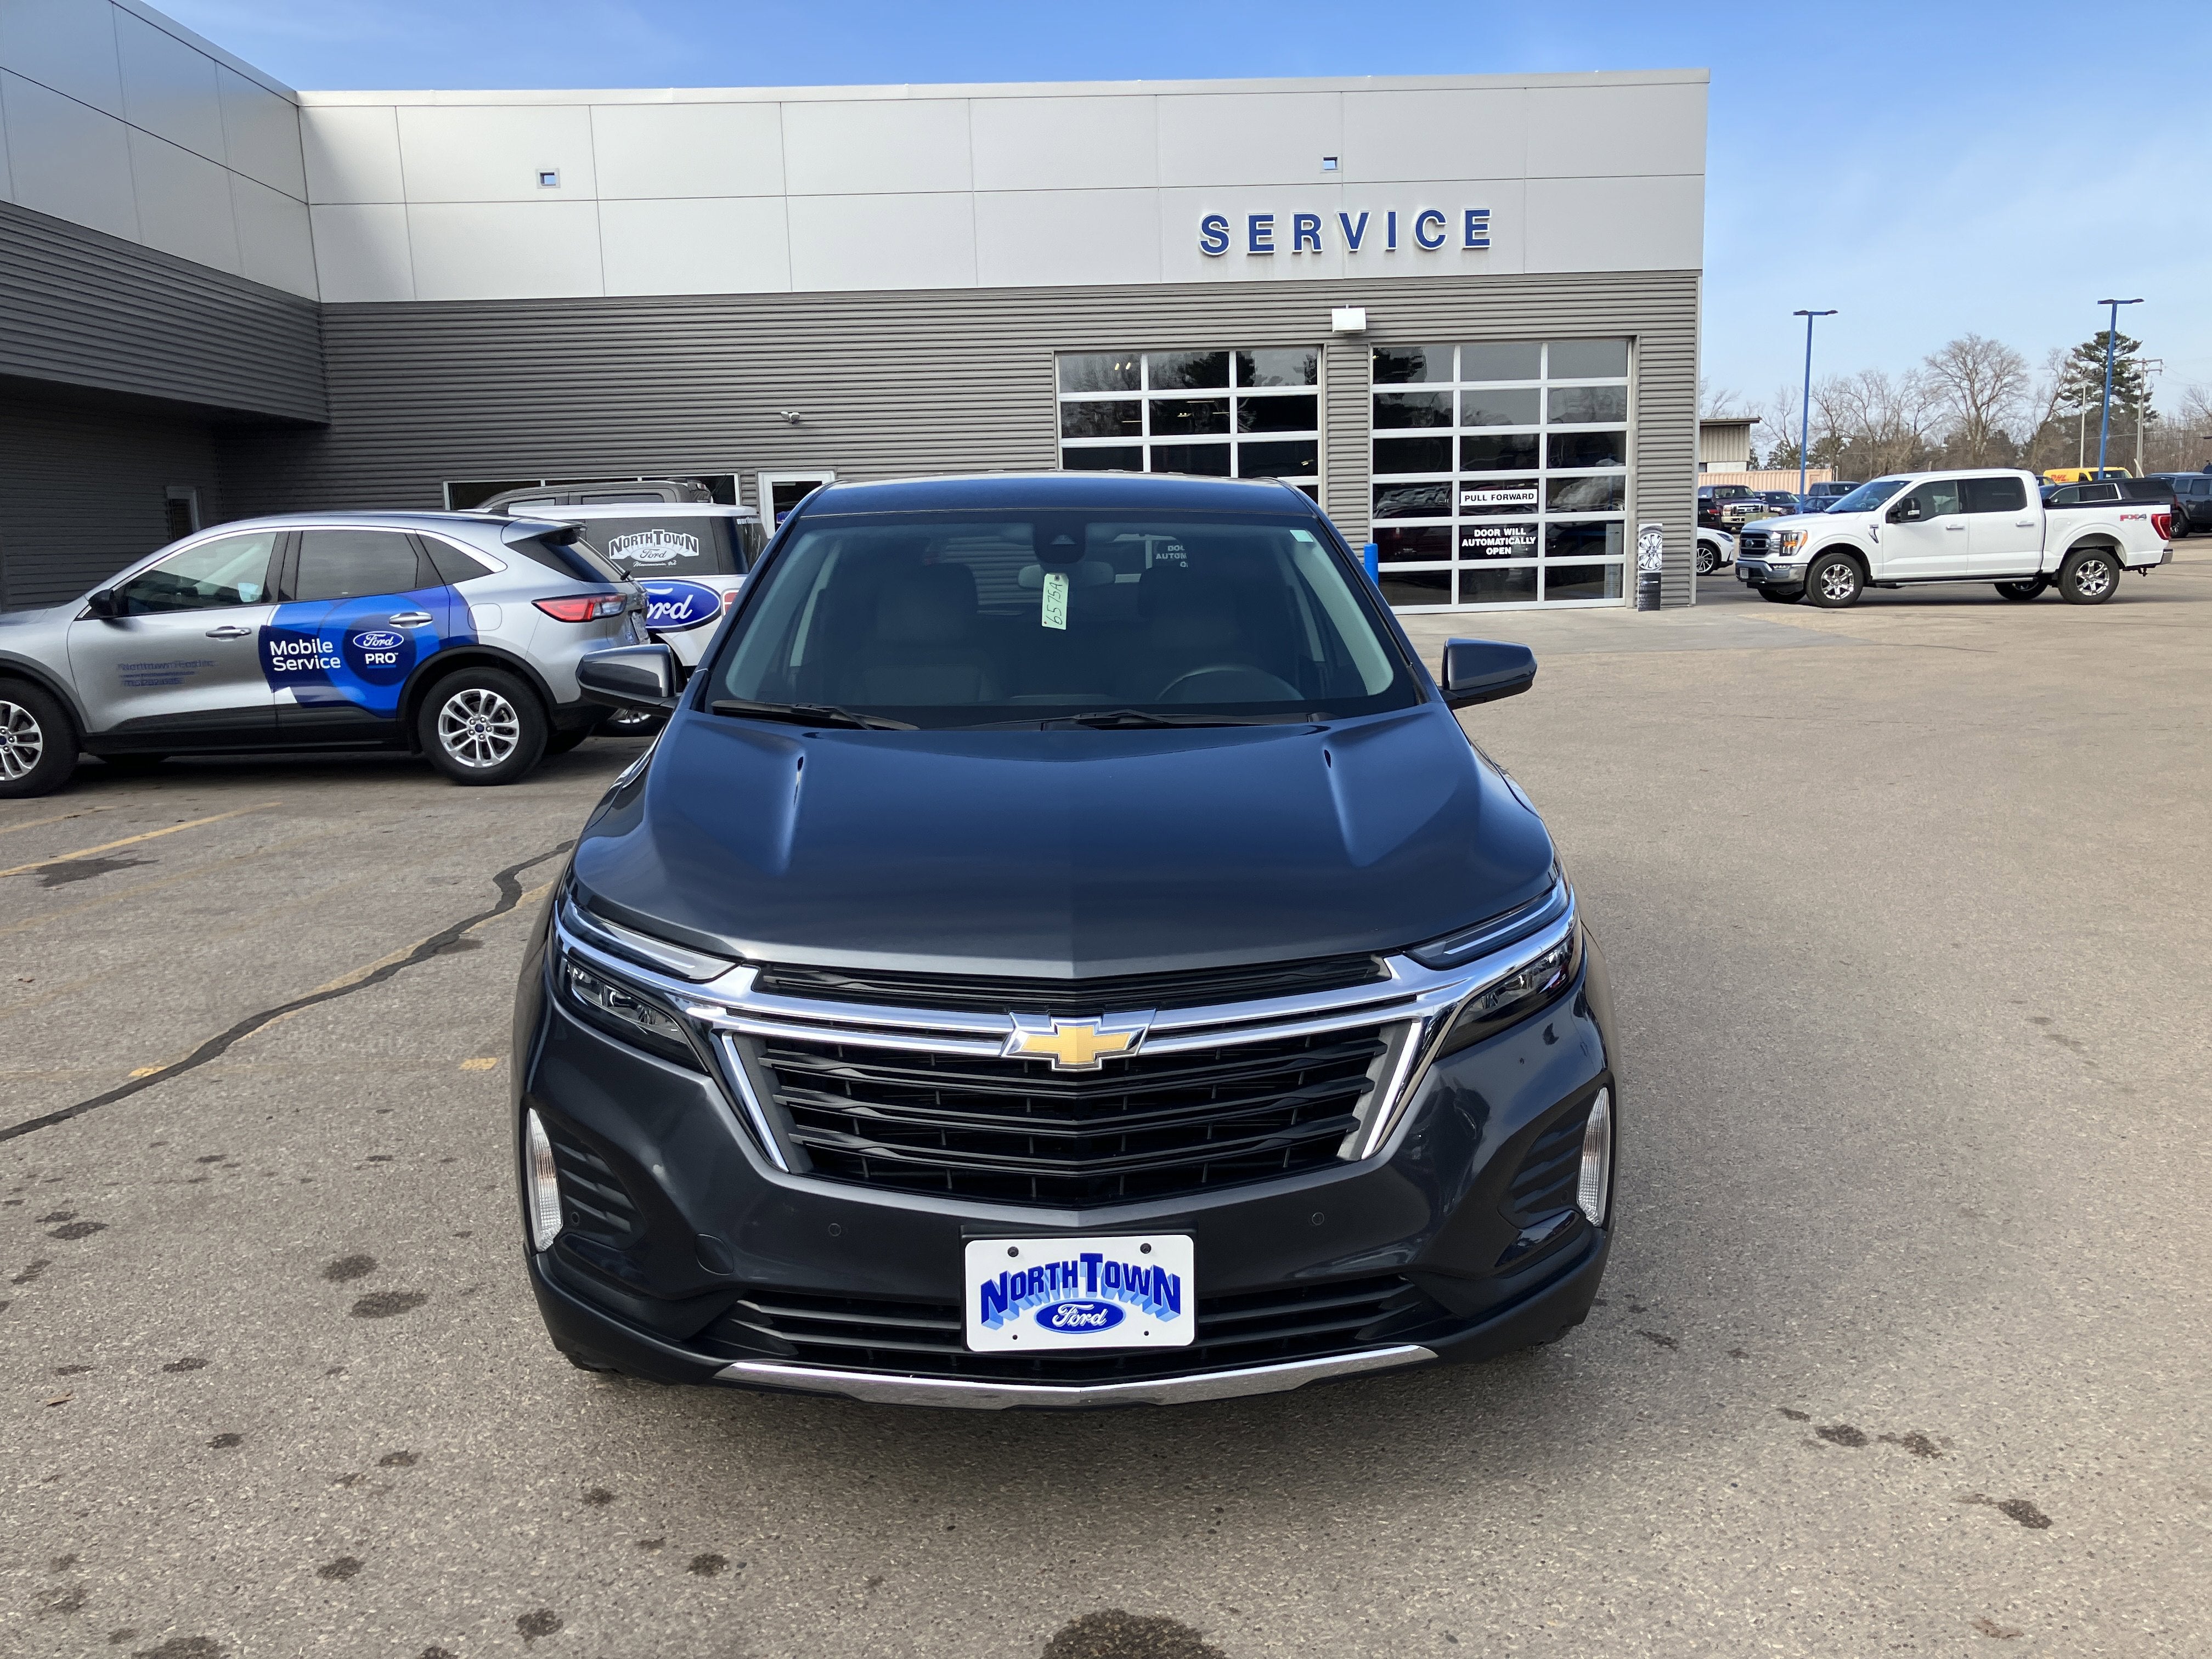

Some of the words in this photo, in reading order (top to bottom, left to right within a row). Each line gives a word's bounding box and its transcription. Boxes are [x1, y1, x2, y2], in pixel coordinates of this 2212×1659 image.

[1199, 208, 1492, 256] SERVICE
[1474, 528, 1501, 537] DOOR
[1504, 528, 1527, 536] WILL
[1462, 537, 1536, 546] AUTOMATICALLY
[640, 549, 667, 558] Ford
[1046, 582, 1063, 625] 6575A
[269, 638, 334, 656] Mobile
[363, 634, 394, 647] Ford
[273, 655, 341, 672] Service
[1052, 1304, 1108, 1327] Ford
